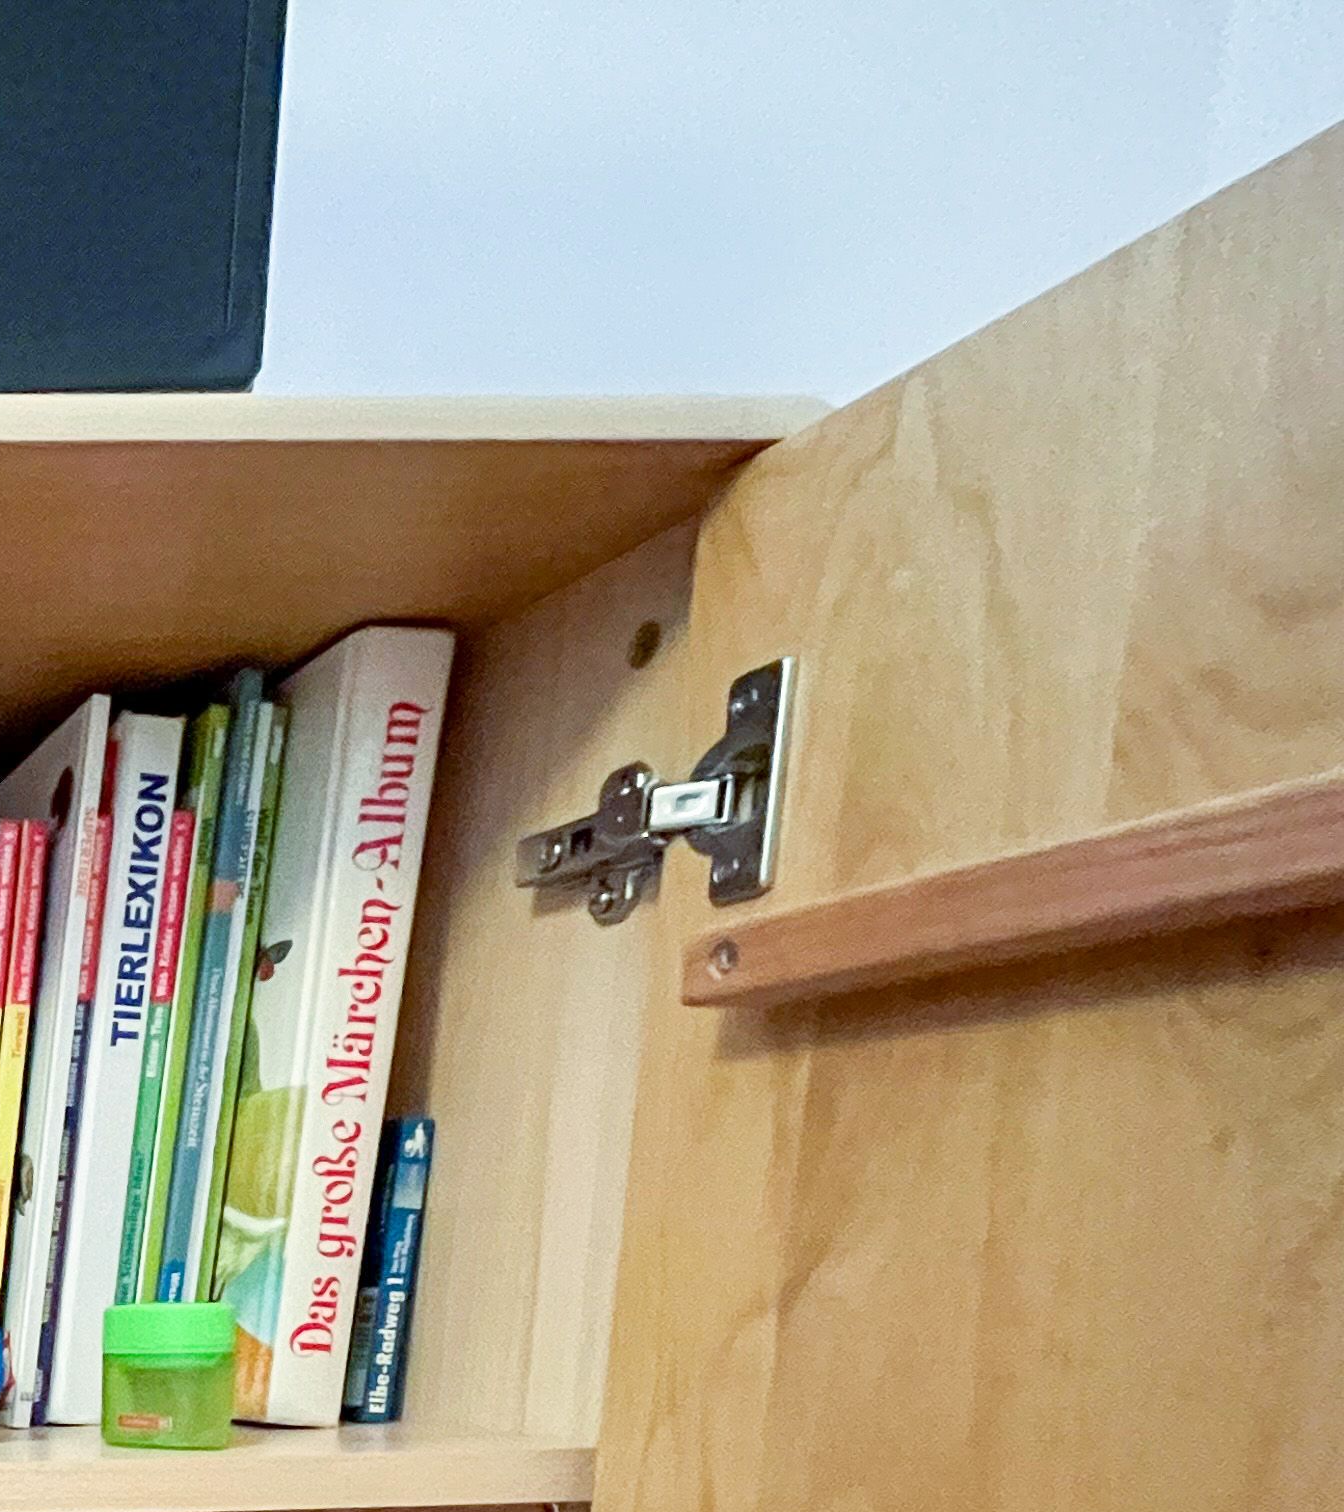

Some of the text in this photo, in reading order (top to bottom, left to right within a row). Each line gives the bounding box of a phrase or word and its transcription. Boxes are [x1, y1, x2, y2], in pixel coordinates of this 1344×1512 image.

[109, 771, 170, 1046] TIERLEXIKON
[11, 1011, 27, 1059] Tierwelt
[289, 699, 432, 1356] Das große Märchen-Album
[368, 1289, 406, 1415] Elbe-Radweg
